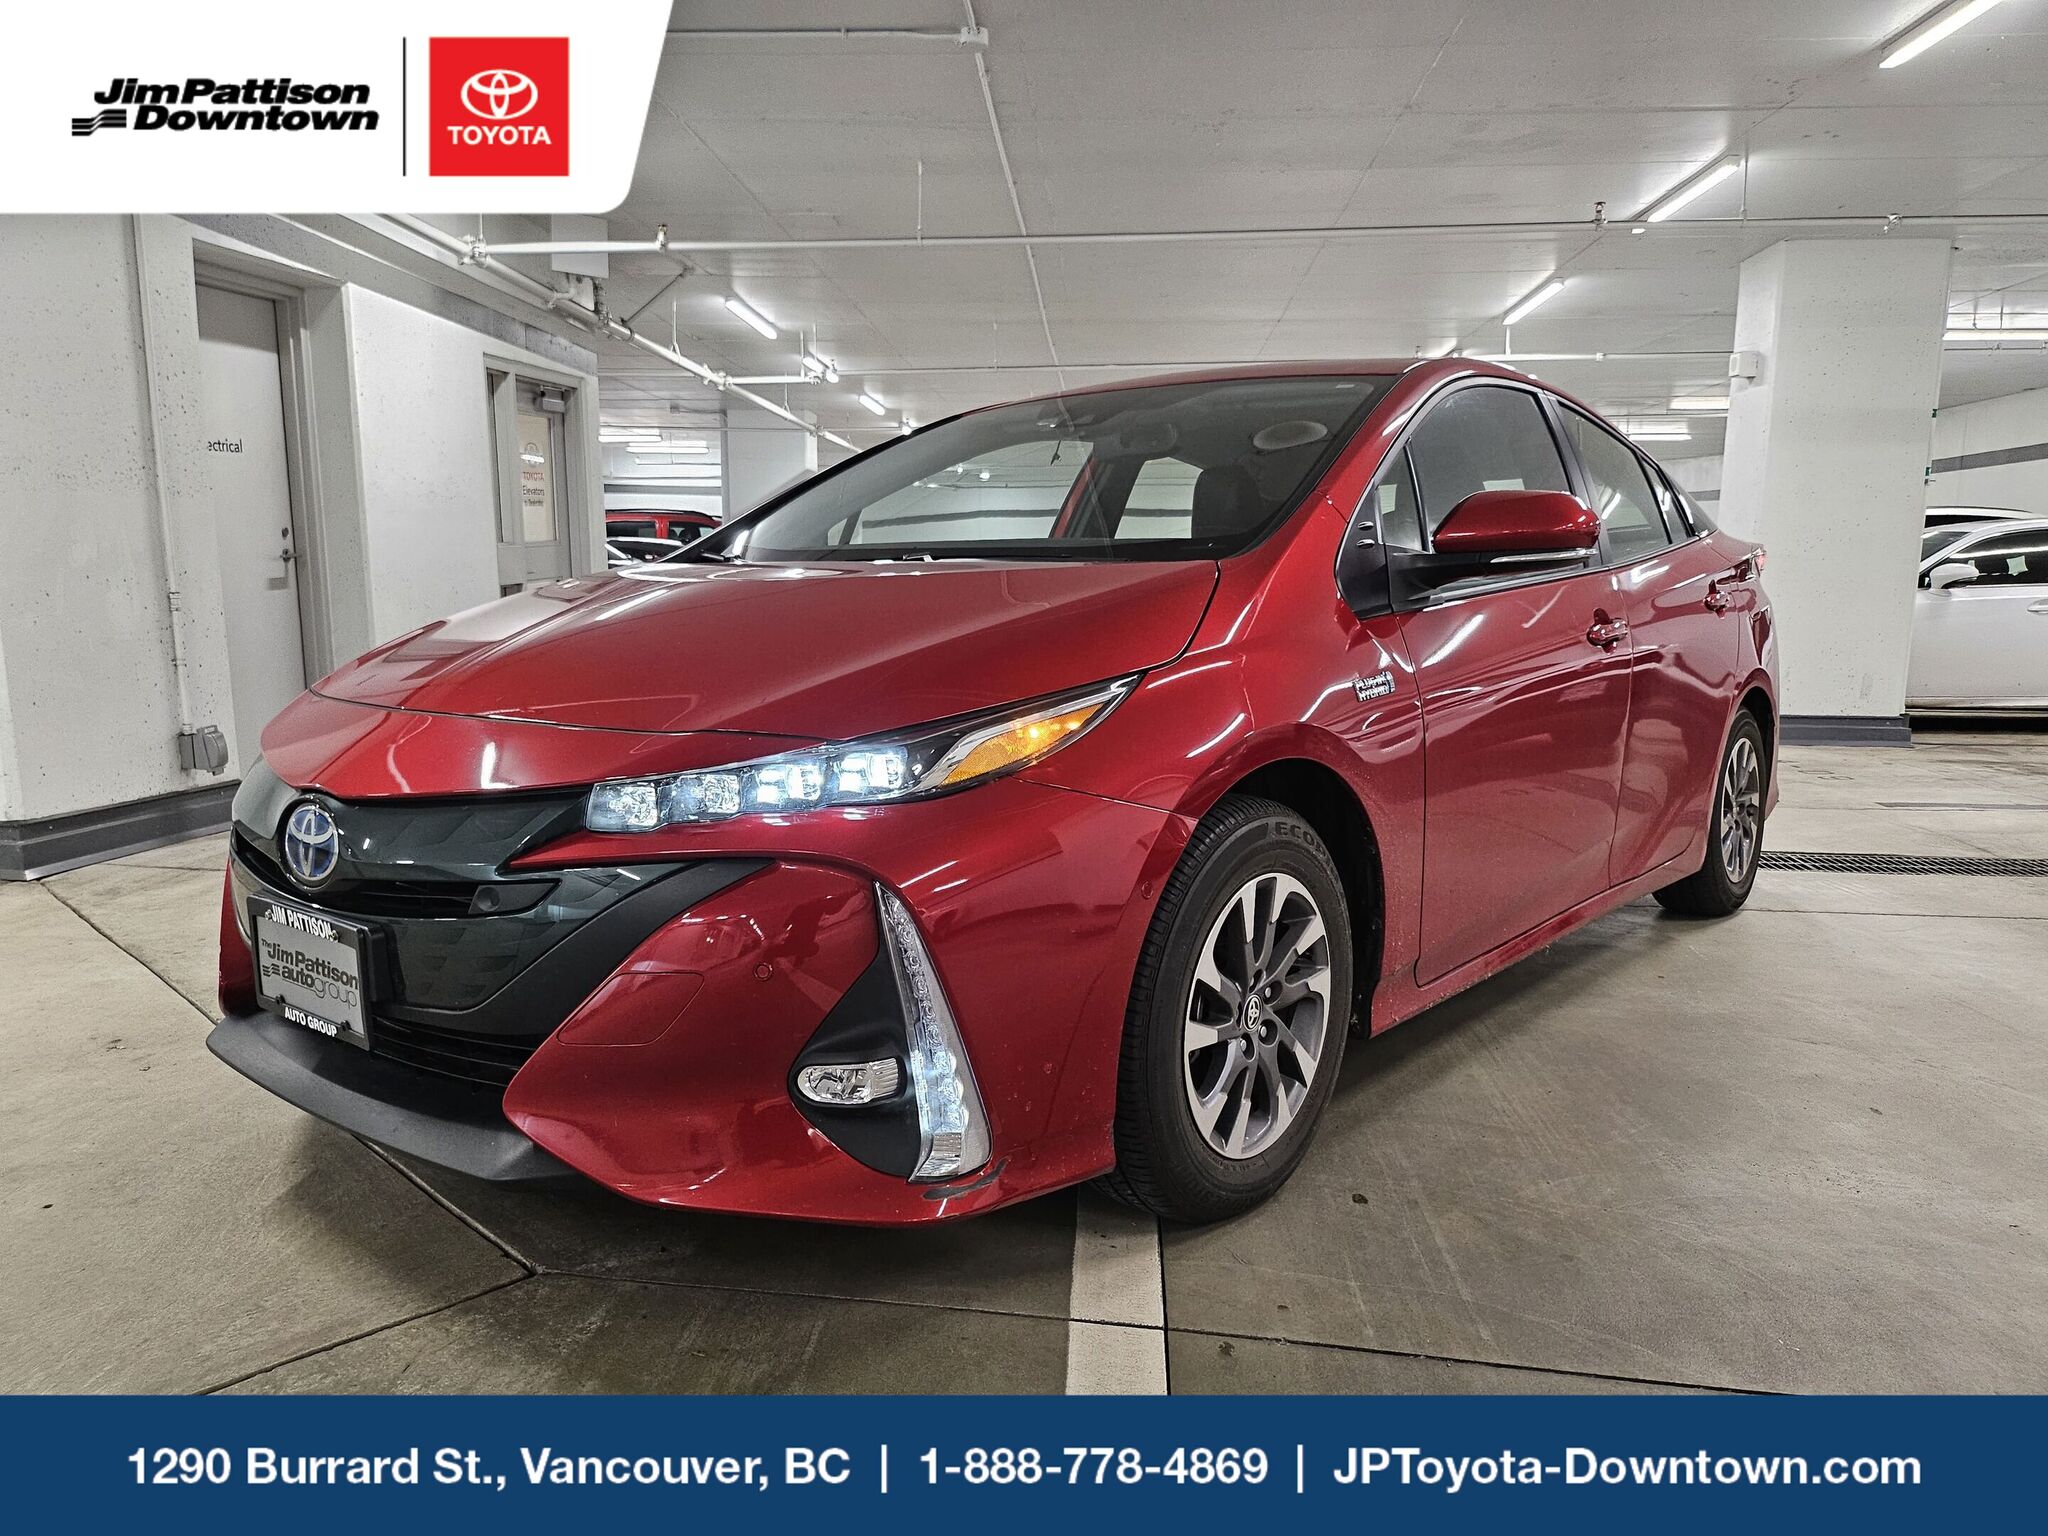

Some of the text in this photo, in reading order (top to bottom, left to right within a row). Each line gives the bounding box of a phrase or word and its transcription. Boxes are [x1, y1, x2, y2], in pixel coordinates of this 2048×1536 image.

[523, 472, 545, 481] TOYOTA
[271, 905, 333, 940] JIM PATTISON
[285, 1007, 338, 1037] AUTO GROUP
